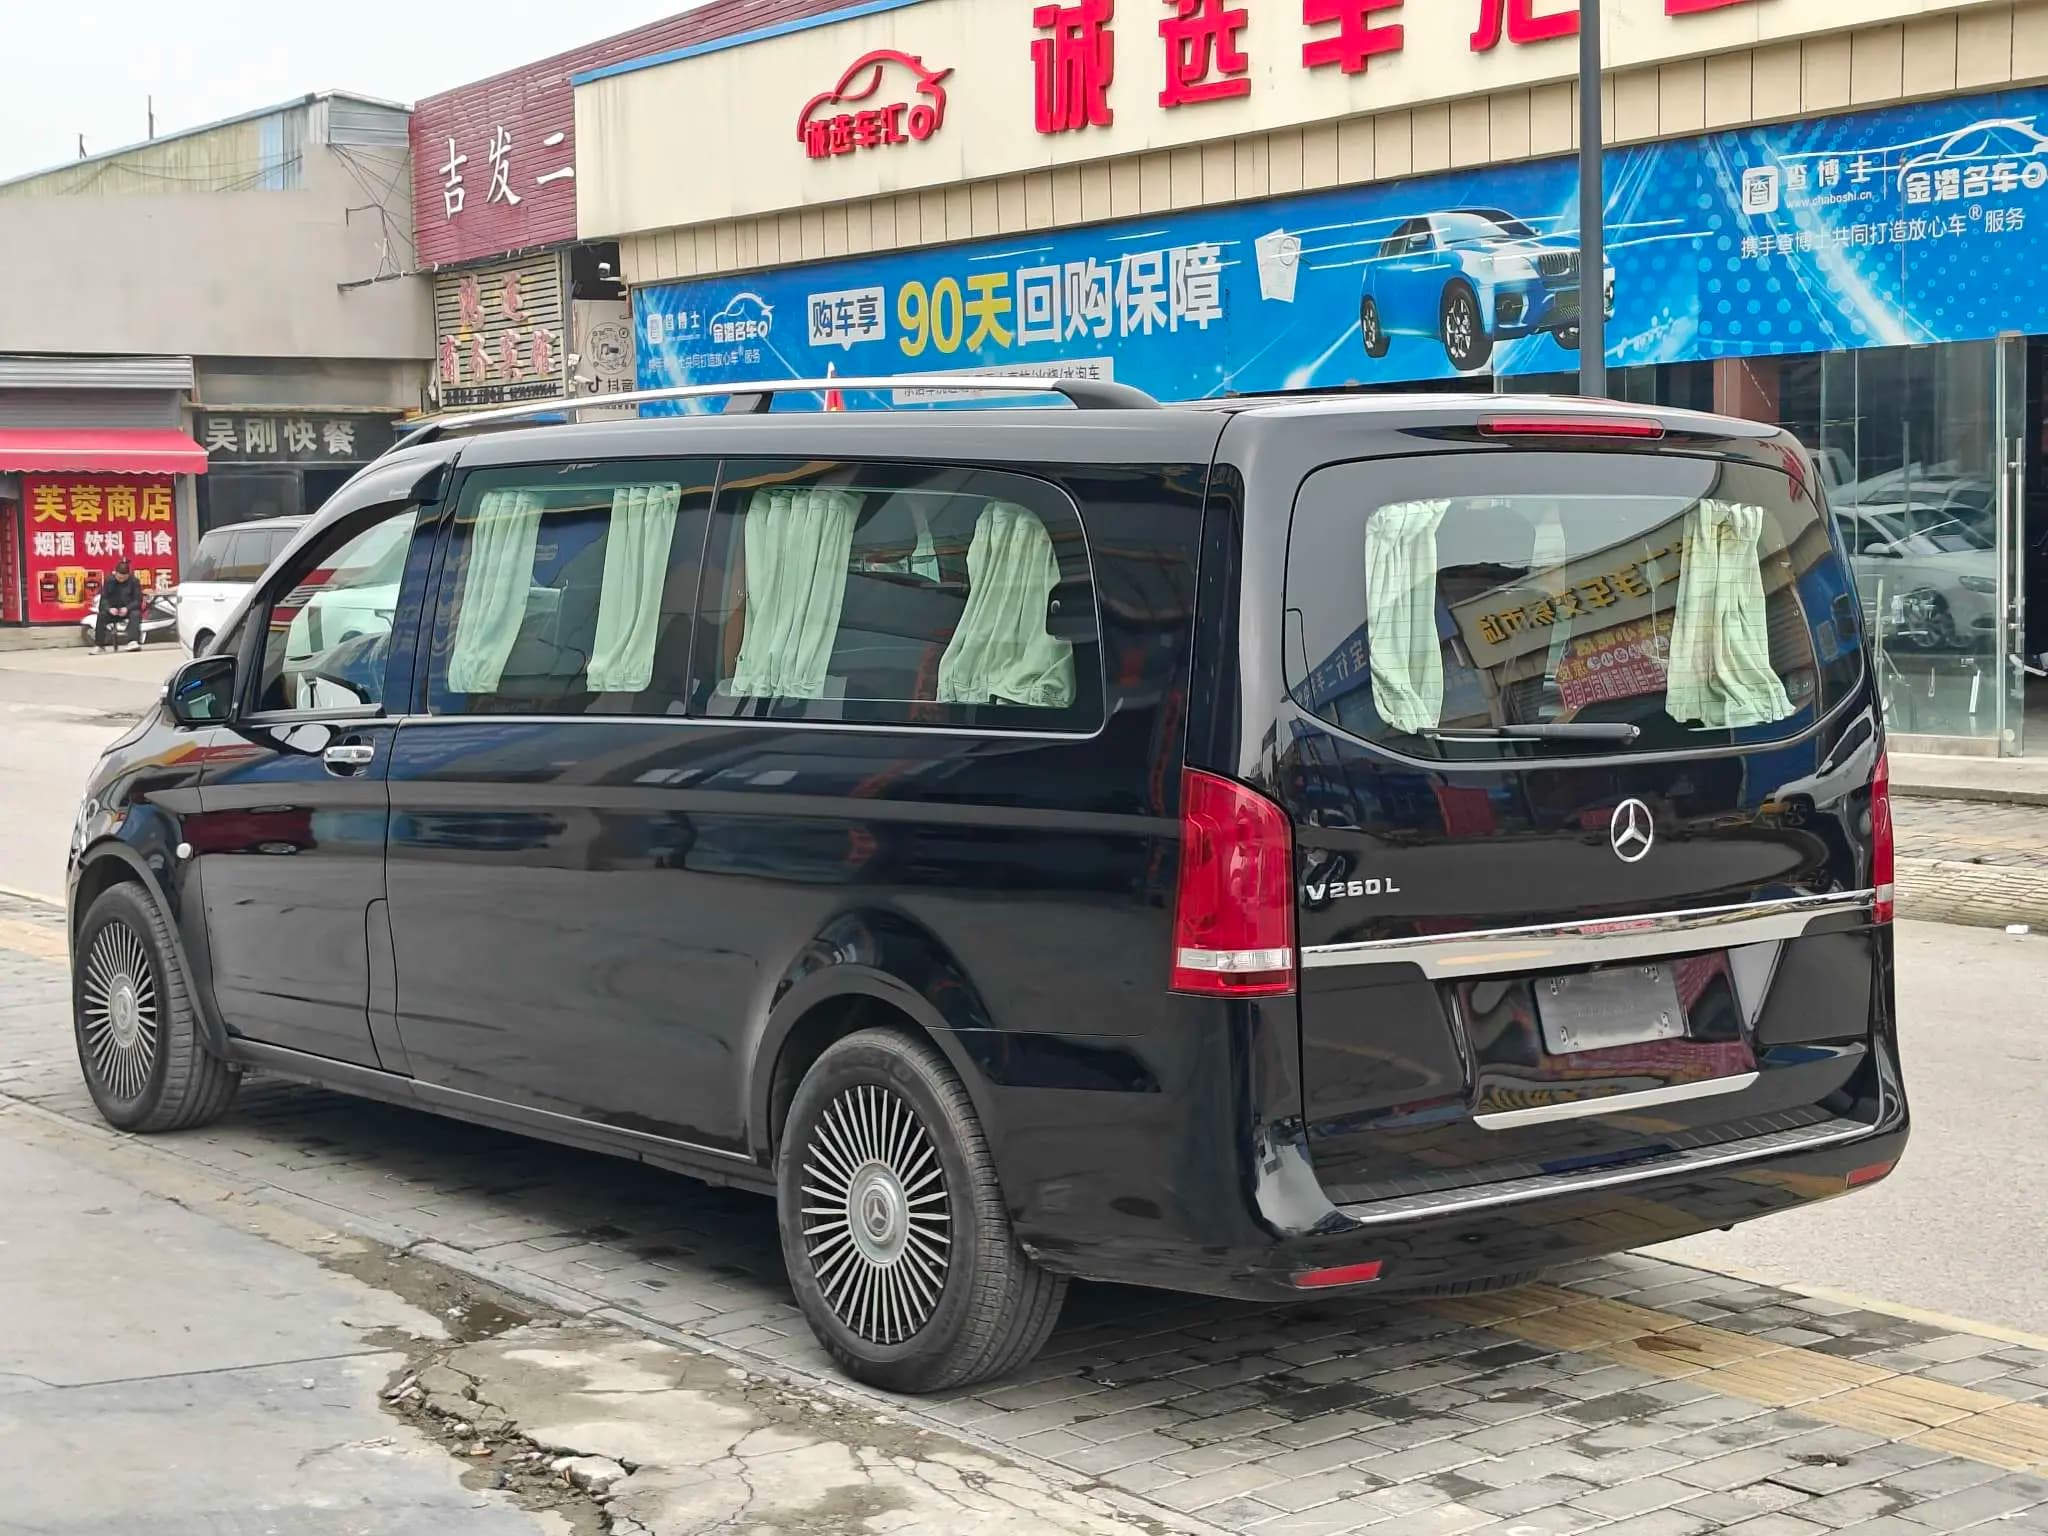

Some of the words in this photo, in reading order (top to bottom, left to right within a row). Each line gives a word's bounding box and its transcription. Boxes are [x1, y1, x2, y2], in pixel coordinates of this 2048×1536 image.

[804, 102, 909, 159] 诚选车汇
[1787, 155, 1872, 191] 查博士
[812, 297, 879, 338] 购车享
[898, 246, 1222, 356] 90天回购保障
[608, 377, 634, 393] 抖音
[206, 417, 355, 455] 吴刚快餐
[33, 484, 172, 523] 芙蓉商店
[34, 531, 75, 557] 烟酒
[85, 531, 124, 557] 饮料
[133, 530, 173, 557] 副食
[1306, 878, 1400, 900] V260L
